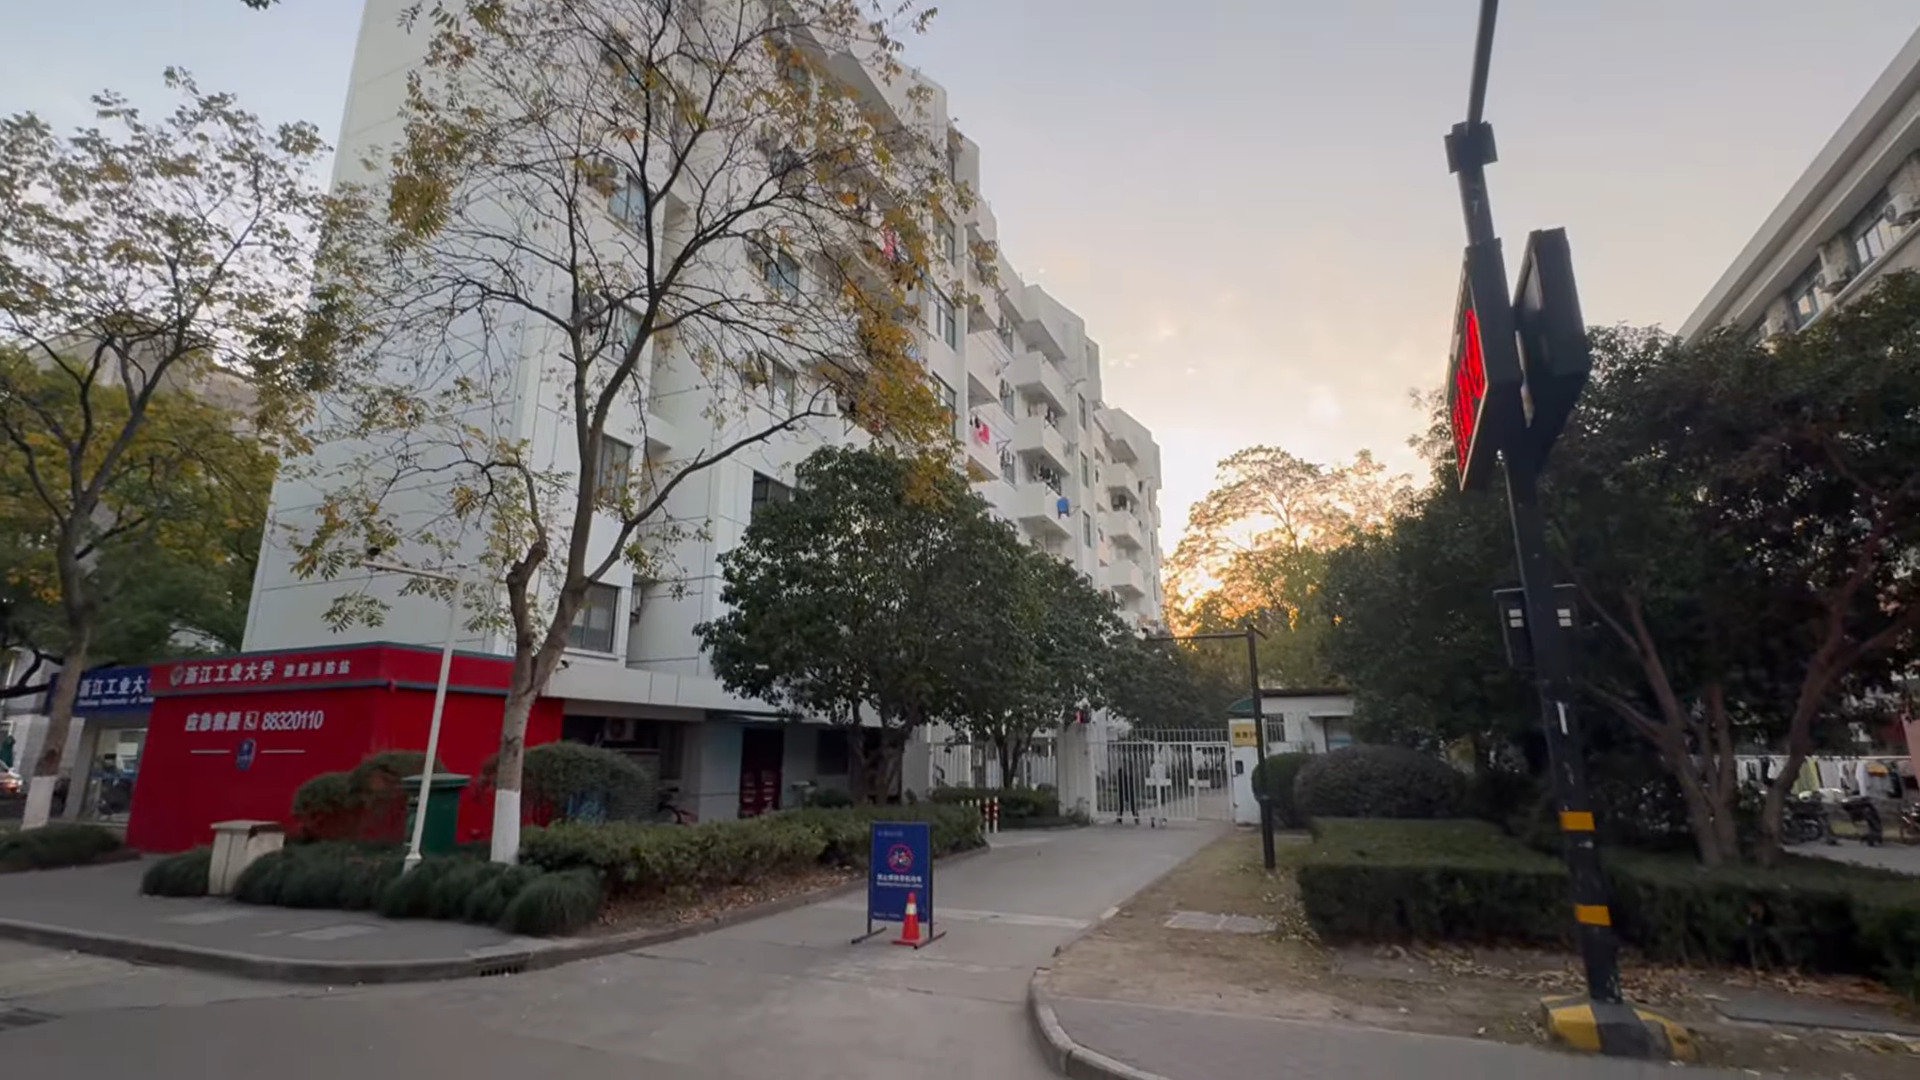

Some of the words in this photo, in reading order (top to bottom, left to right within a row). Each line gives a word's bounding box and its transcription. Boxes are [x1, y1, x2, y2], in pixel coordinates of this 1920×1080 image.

[183, 660, 275, 685] 浙江工业大学
[79, 675, 152, 698] 浙江工业大
[261, 710, 324, 731] 88320110
